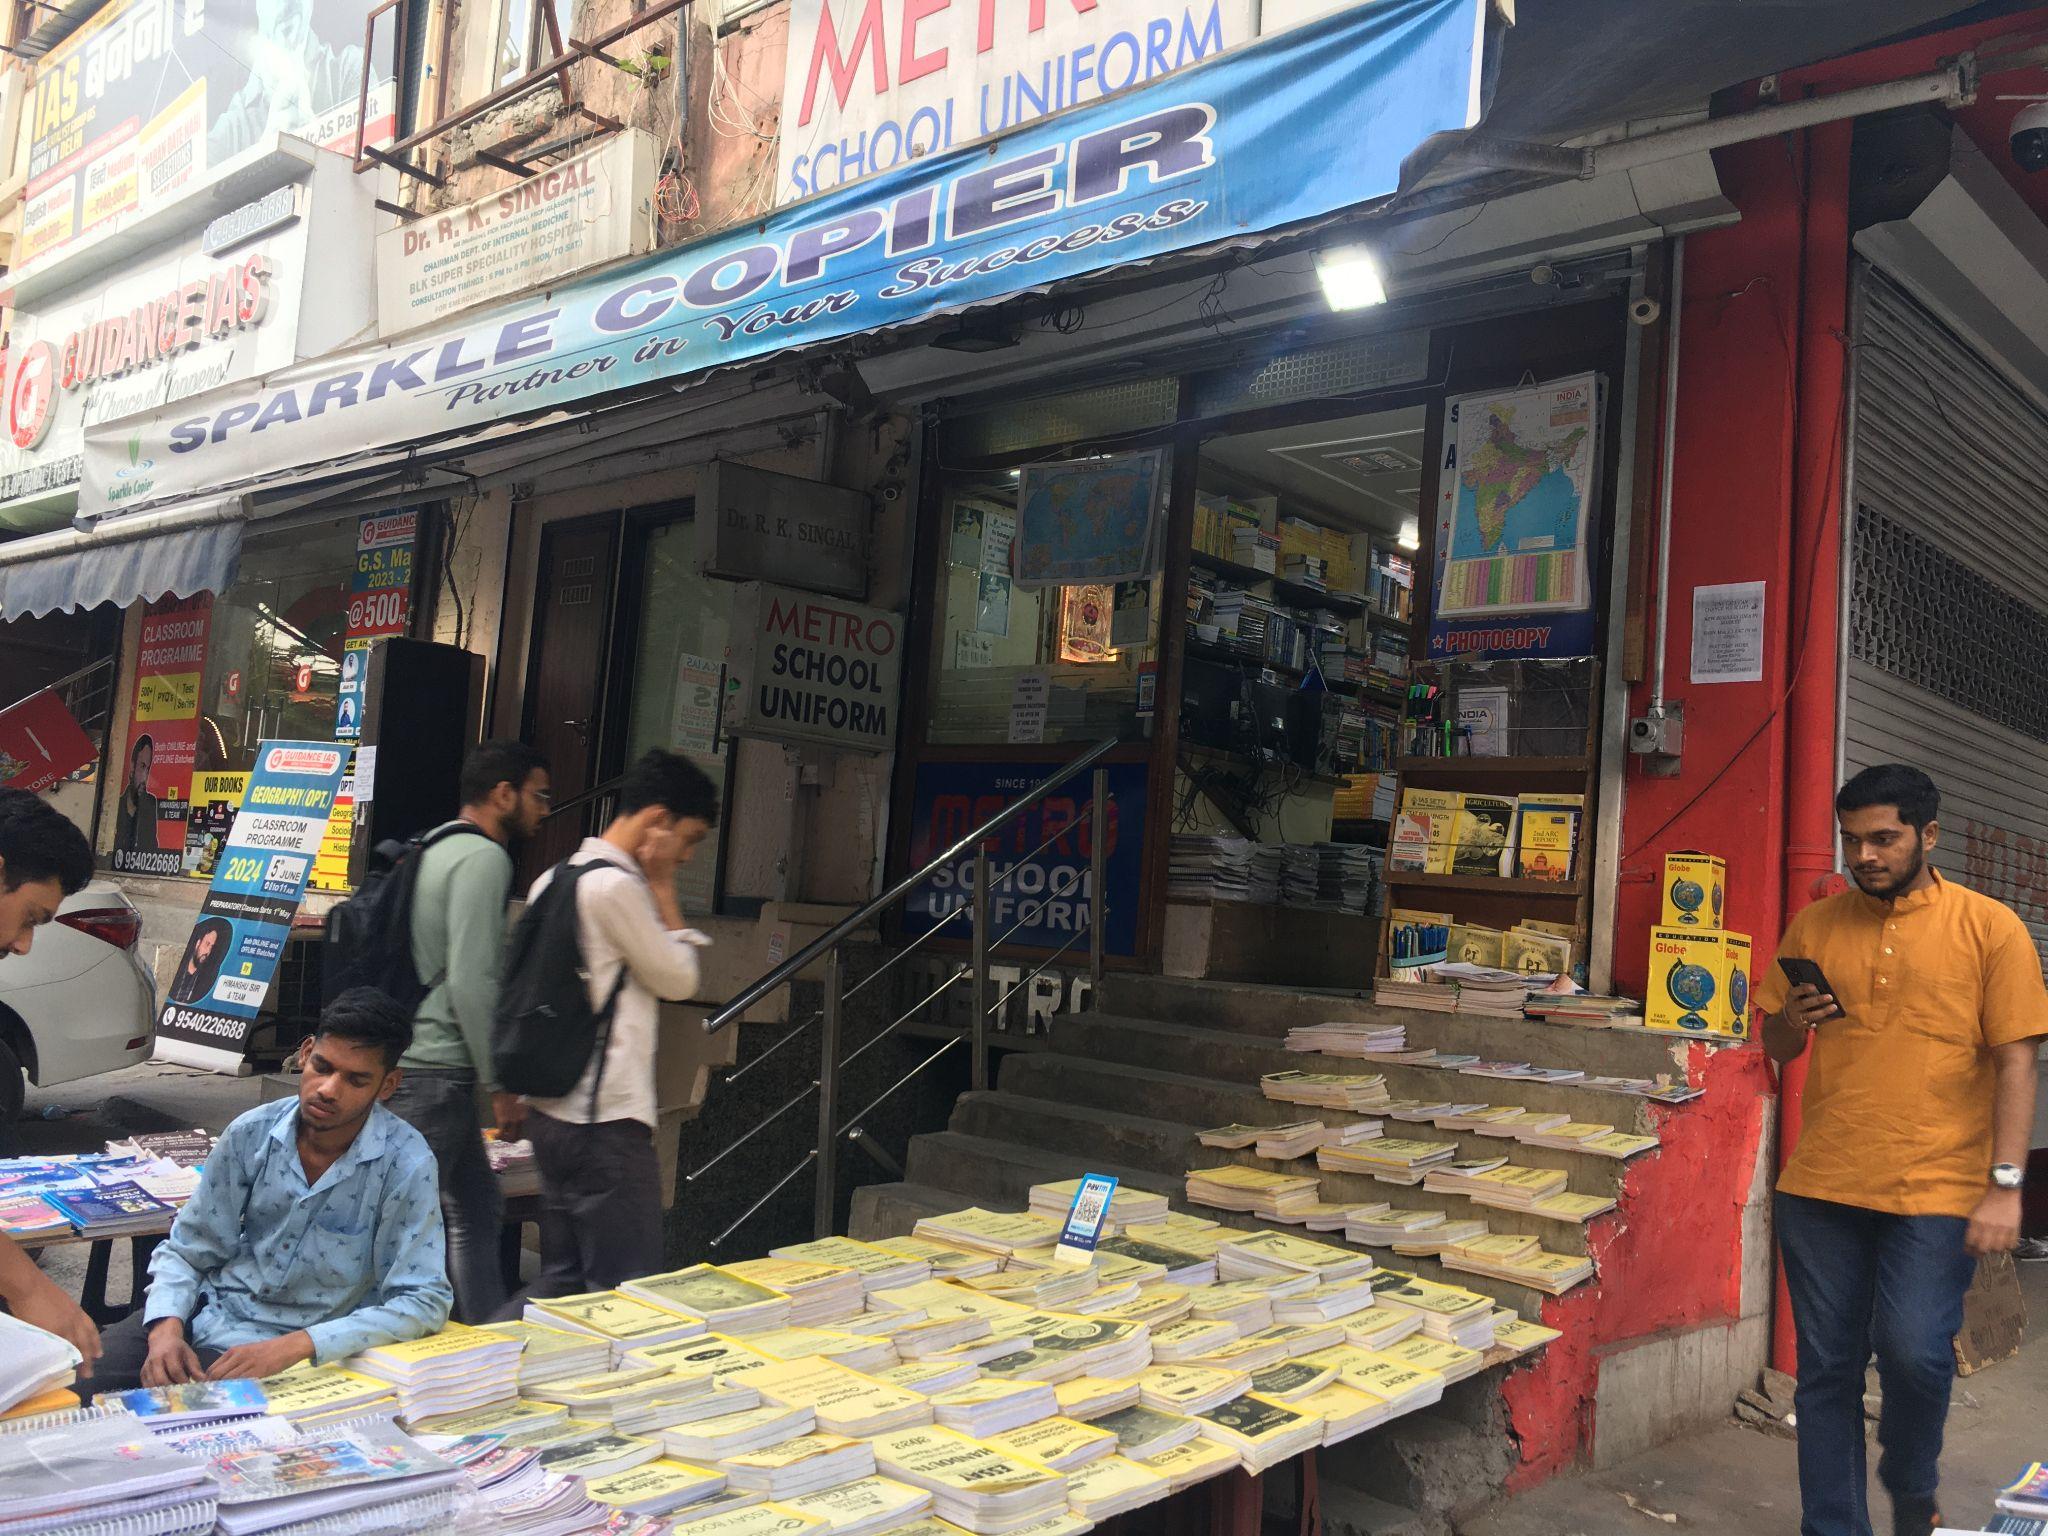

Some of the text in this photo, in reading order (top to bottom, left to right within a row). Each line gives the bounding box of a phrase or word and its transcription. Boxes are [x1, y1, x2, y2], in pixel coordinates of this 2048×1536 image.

[979, 0, 1224, 136] UNIFORM
[34, 56, 80, 143] IAS
[403, 229, 431, 257] Dr.
[437, 215, 460, 243] R.
[466, 206, 491, 232] K.
[499, 160, 596, 221] SINGAL
[594, 103, 1217, 335] COPIER
[423, 211, 570, 275] CHAIRMAN DEPT. OF INTERNAL MEDICINE
[409, 275, 429, 296] BLK
[430, 261, 464, 290] SUPER
[466, 241, 528, 278] SPECIALITY
[530, 220, 587, 255] HOSPITAL
[411, 281, 457, 308] CONSULTATION
[457, 273, 484, 293] TIMINGS
[434, 304, 448, 314] FOR
[448, 291, 486, 310] EMERGENCY
[446, 198, 1209, 411] Partner in Your Success
[60, 253, 270, 390] GUIDANCE IAS
[168, 307, 560, 454] SPARKLE
[100, 383, 146, 422] Choice
[1556, 390, 1582, 402] INDIA
[108, 480, 154, 502] Sparkle Copier
[727, 508, 858, 555] Dr. R. K. SINGAL
[359, 552, 386, 572] G.S.
[369, 571, 395, 588] 2023
[143, 620, 205, 644] CLASSROOM
[766, 597, 896, 656] METRO
[345, 641, 357, 651] GET
[1446, 627, 1551, 652] PHOTOCOPY
[141, 645, 203, 667] PROGRAMME
[772, 643, 883, 694] SCHOOL
[182, 682, 196, 695] Test
[761, 684, 888, 737] UNIFORM
[283, 750, 336, 763] GUIDANCE IAS
[204, 776, 243, 793] OUR BOOKS
[994, 778, 1025, 789] SINCE
[251, 818, 308, 833] CLASSROOM
[929, 795, 1119, 866] METRO
[1533, 830, 1559, 839] 2nd ARC
[246, 833, 304, 849] PROGRAMME
[1532, 837, 1559, 845] REPORTS
[123, 850, 180, 874] 9540226688
[224, 857, 263, 882] 2024
[1668, 863, 1691, 874] Globe
[280, 869, 301, 882] JUNE
[281, 908, 292, 920] May
[1655, 942, 1687, 955] Globe
[1657, 934, 1718, 943] EDUCATION
[1725, 949, 1740, 960] Globe
[232, 992, 247, 1001] TEAM
[250, 982, 262, 993] SIR
[175, 1011, 246, 1040] 9540226688
[1379, 1371, 1421, 1388] NCERT
[910, 1447, 995, 1473] HANDOUTS
[958, 1464, 1015, 1483] ESSAY
